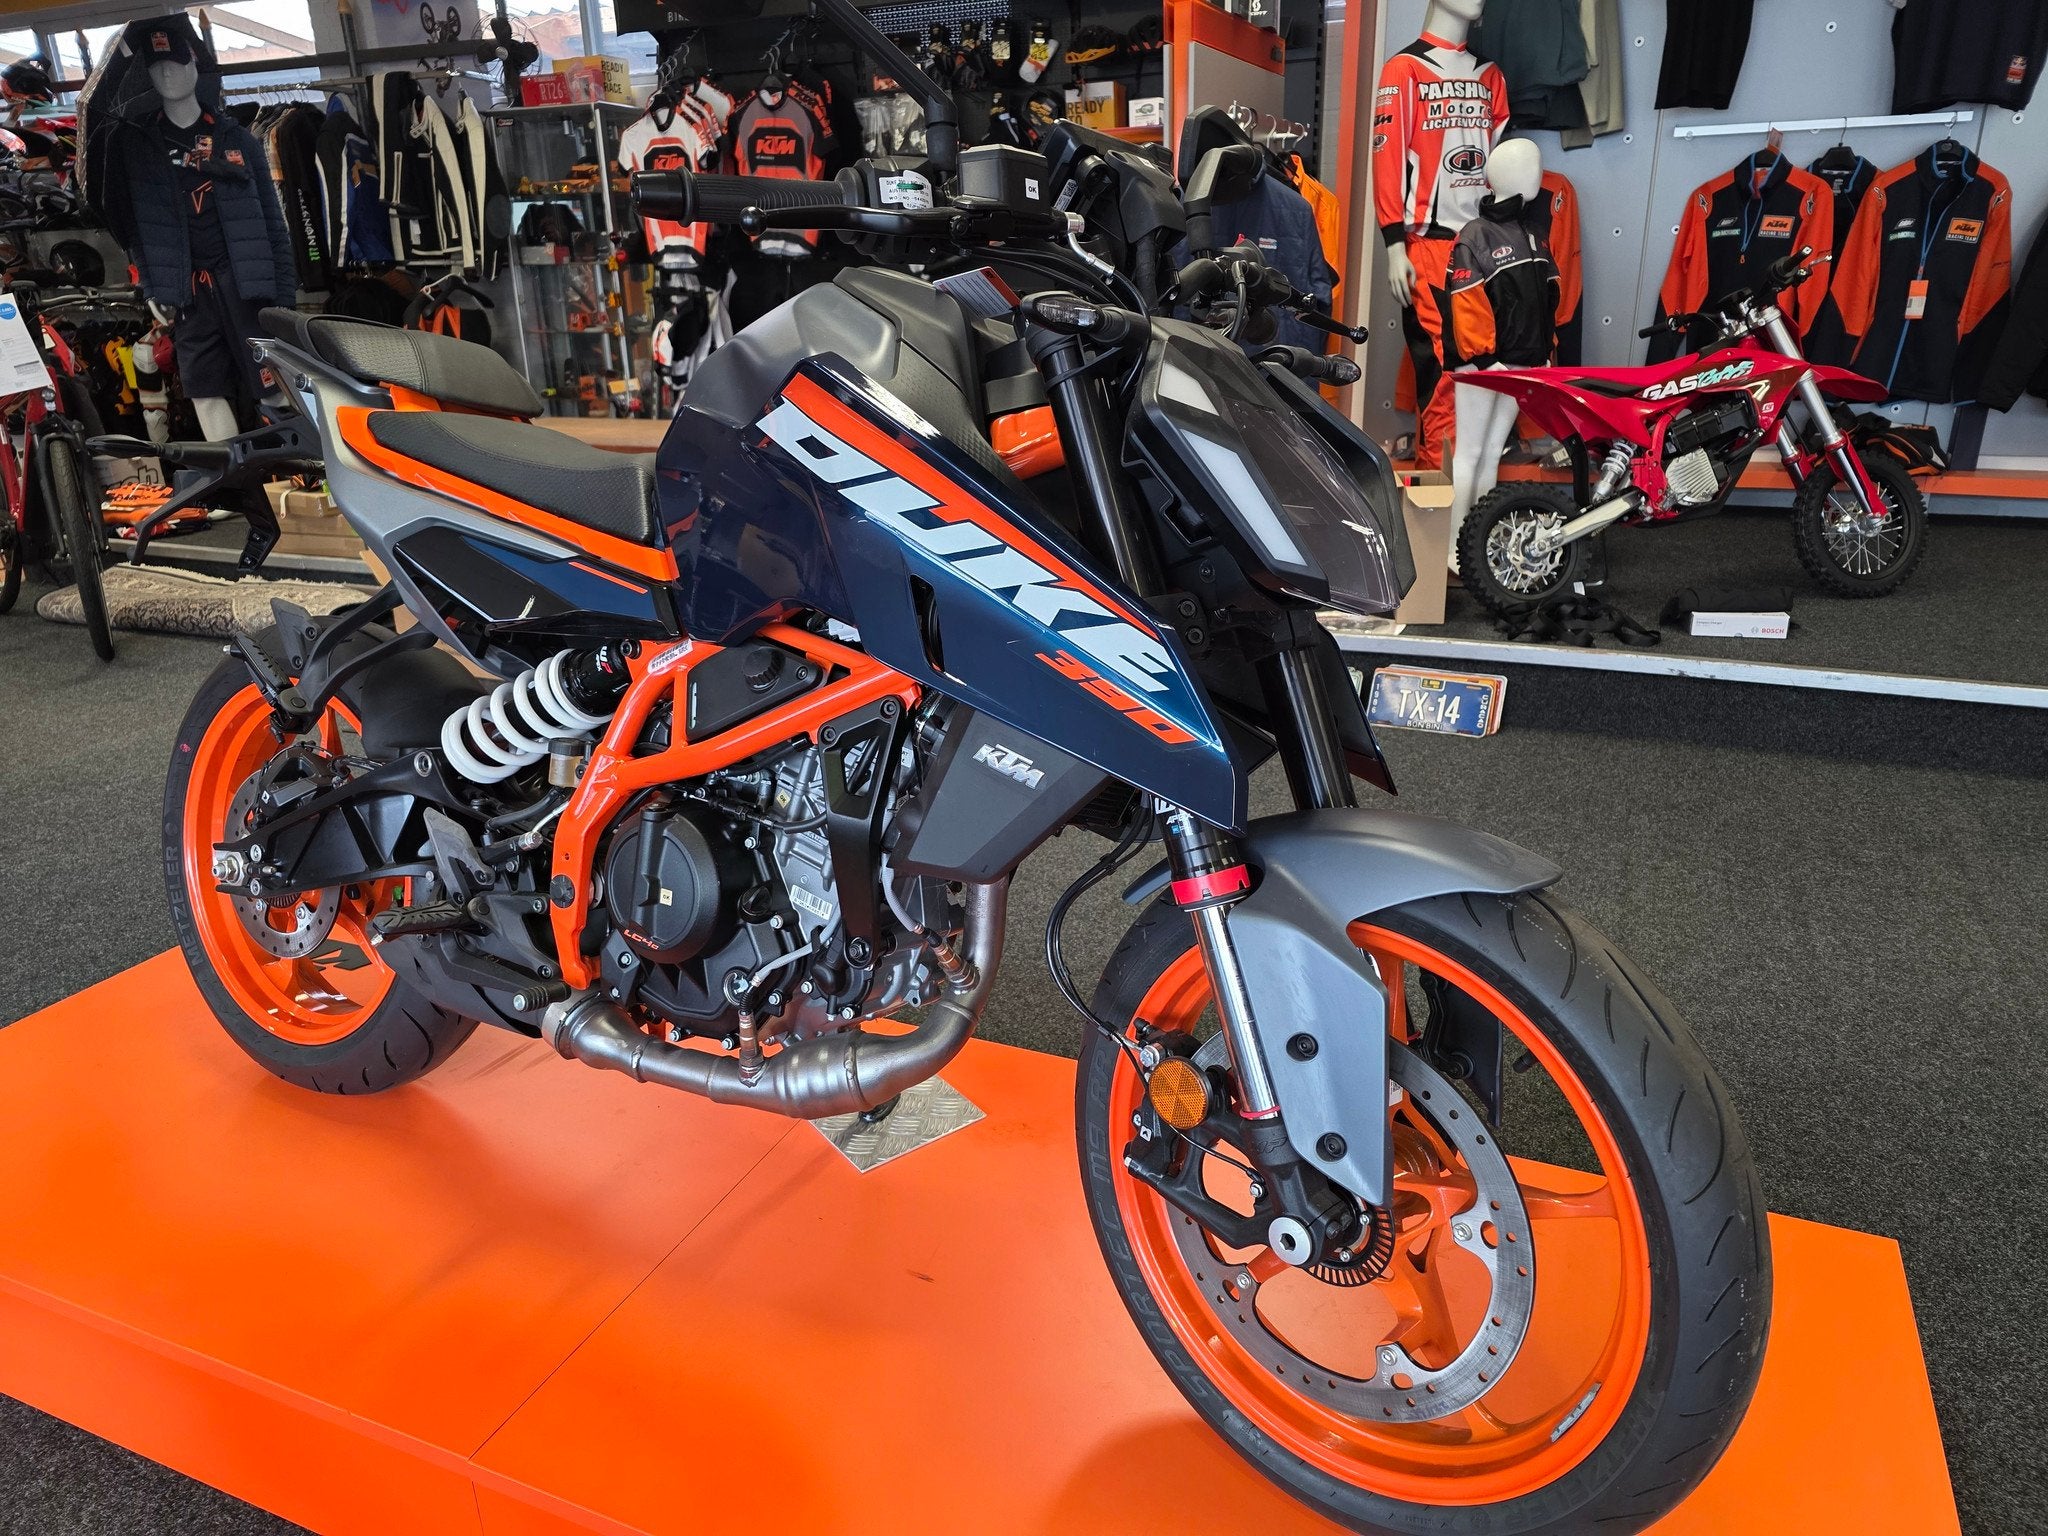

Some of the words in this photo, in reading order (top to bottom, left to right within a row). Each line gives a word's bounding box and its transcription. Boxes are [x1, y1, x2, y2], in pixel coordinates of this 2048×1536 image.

[601, 60, 624, 72] READY
[602, 71, 612, 81] TO
[604, 82, 622, 93] RACE
[1067, 100, 1105, 114] READY
[756, 135, 796, 155] KTM
[653, 153, 686, 171] KTM
[1766, 220, 1788, 228] KTM
[1954, 223, 1976, 233] KTM
[756, 398, 1177, 692] DUKE
[1035, 649, 1197, 744] 390
[1370, 683, 1381, 714] 1986
[1398, 689, 1461, 725] TX-14
[1406, 719, 1424, 729] BON
[1425, 721, 1444, 731] BINI
[972, 743, 1046, 790] KTM
[165, 845, 205, 967] METZELER
[1088, 1047, 1110, 1113] RR
[1098, 1202, 1214, 1399] SPORTEC
